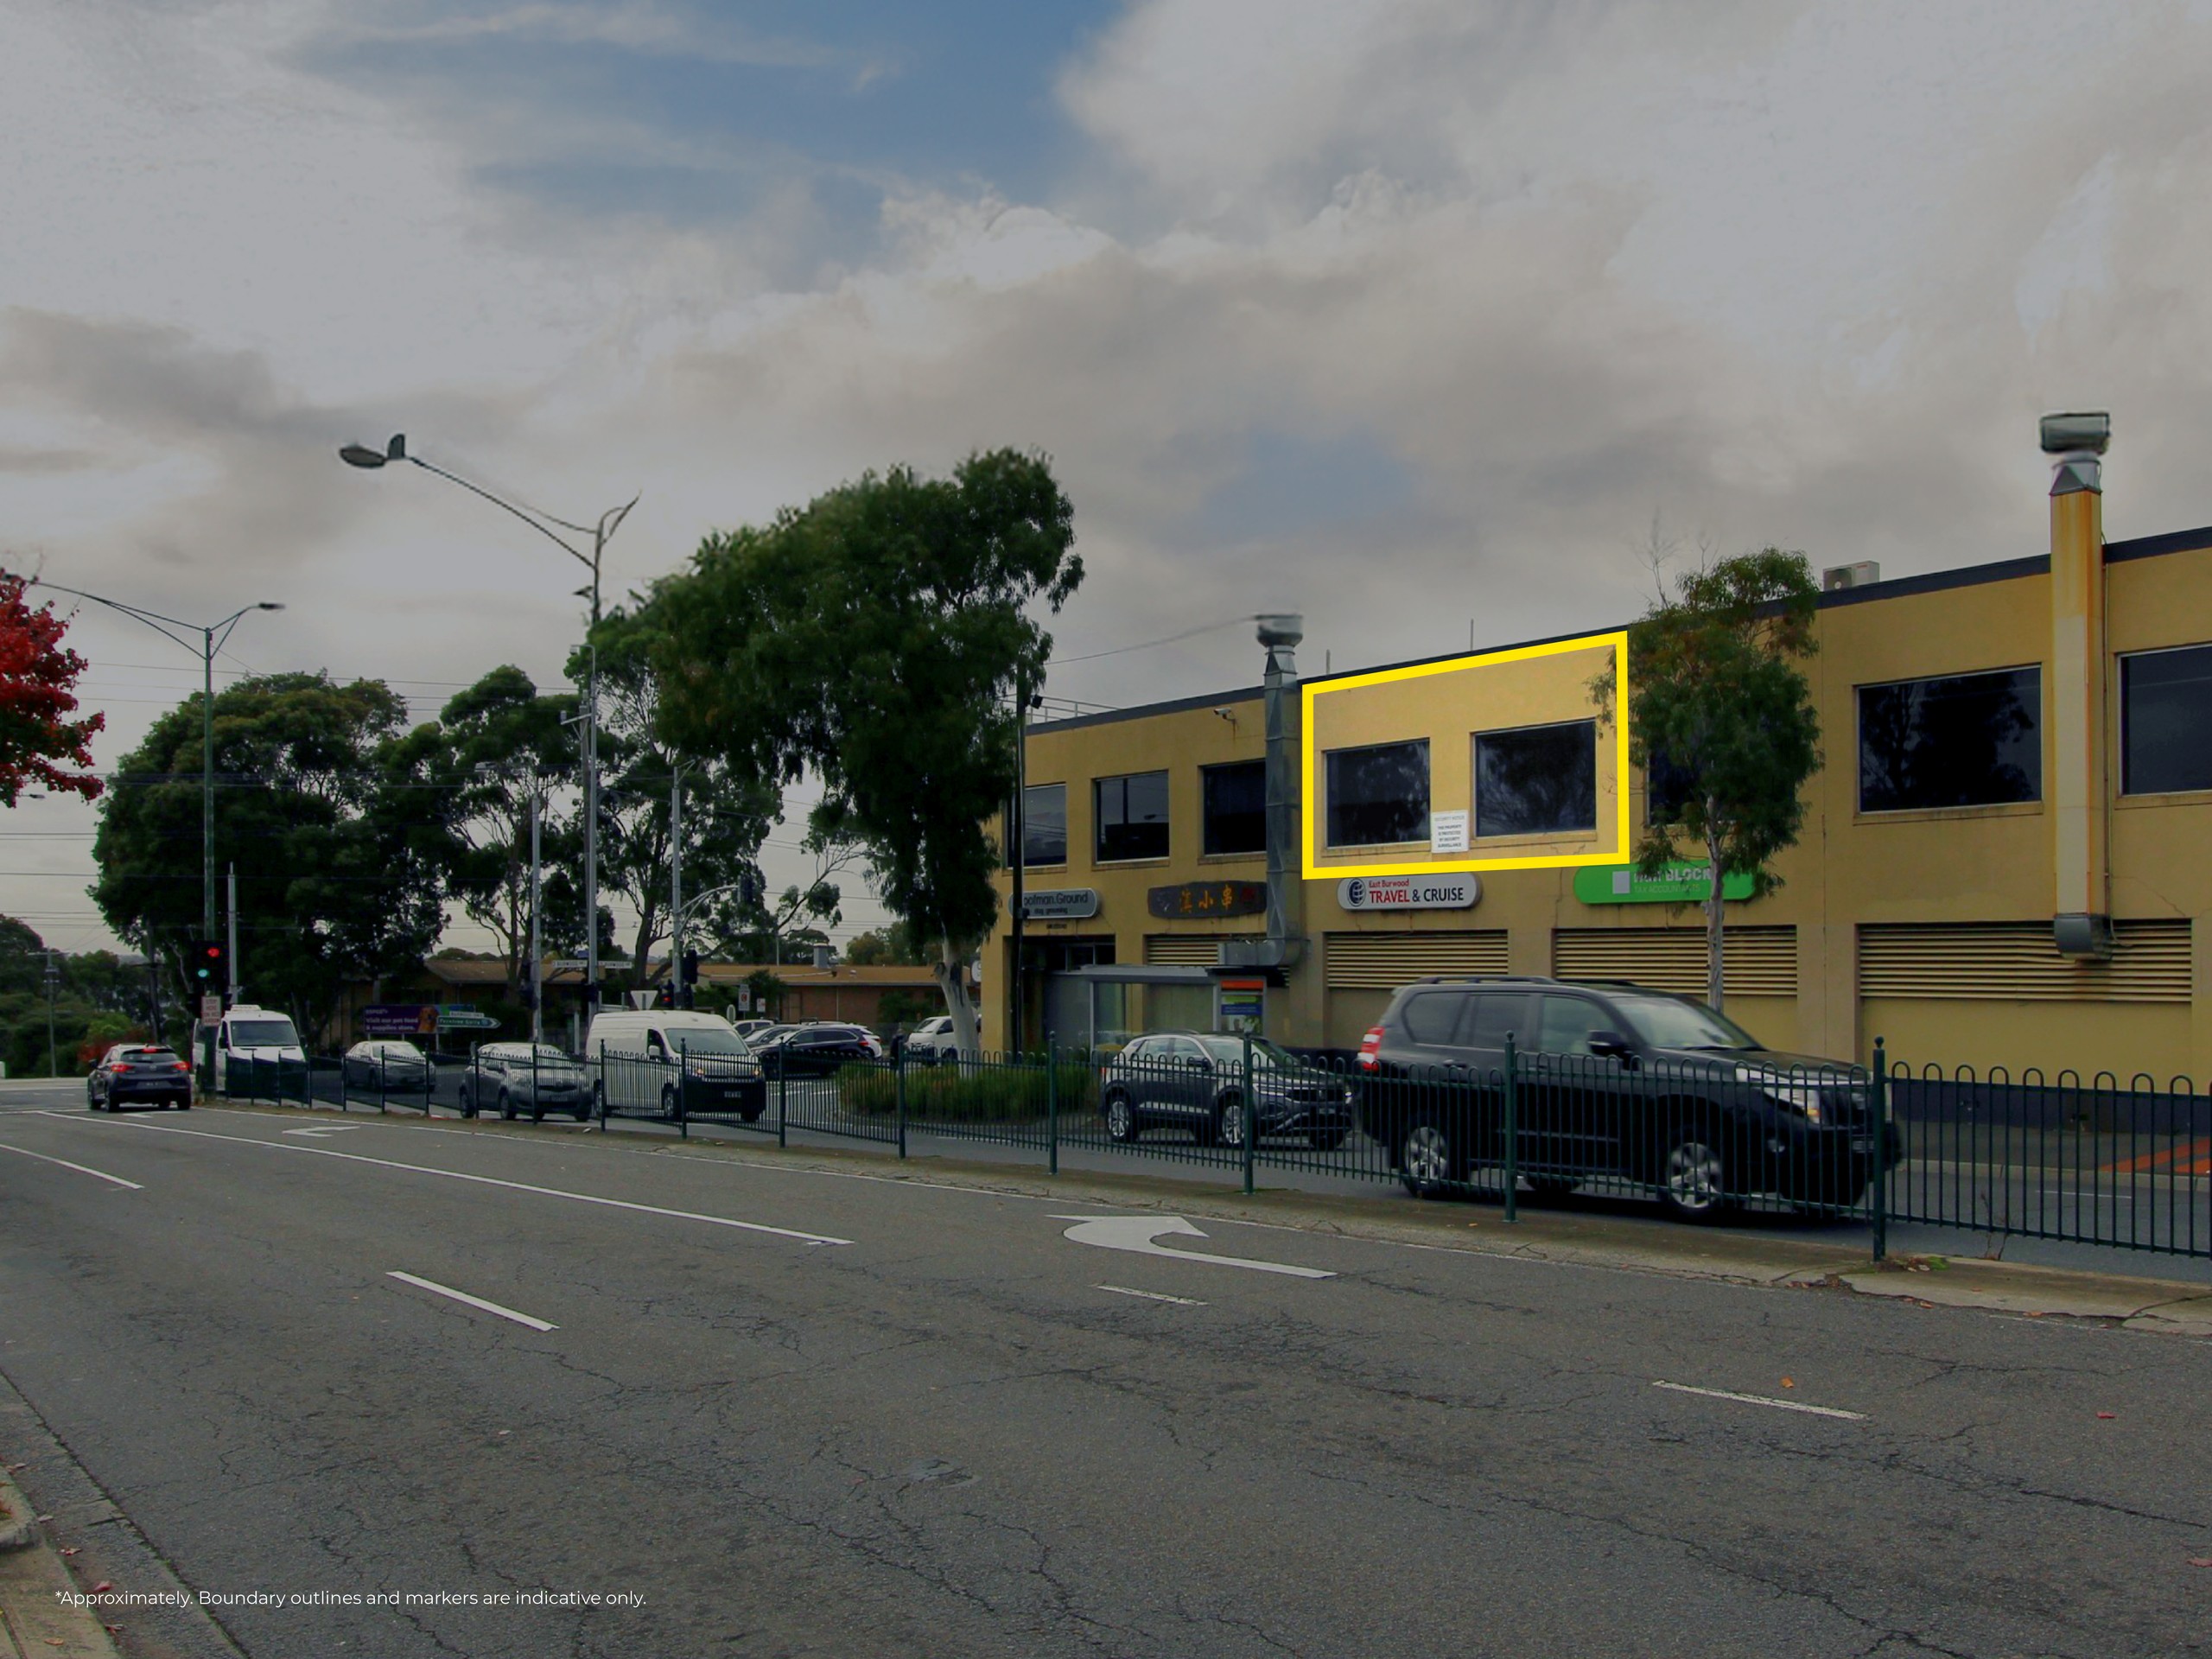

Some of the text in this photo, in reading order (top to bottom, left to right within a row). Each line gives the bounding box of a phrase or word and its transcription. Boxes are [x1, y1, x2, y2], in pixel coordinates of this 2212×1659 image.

[1382, 878, 1409, 888] Burwood
[1369, 887, 1464, 904] TRAVEL & CRUISE
